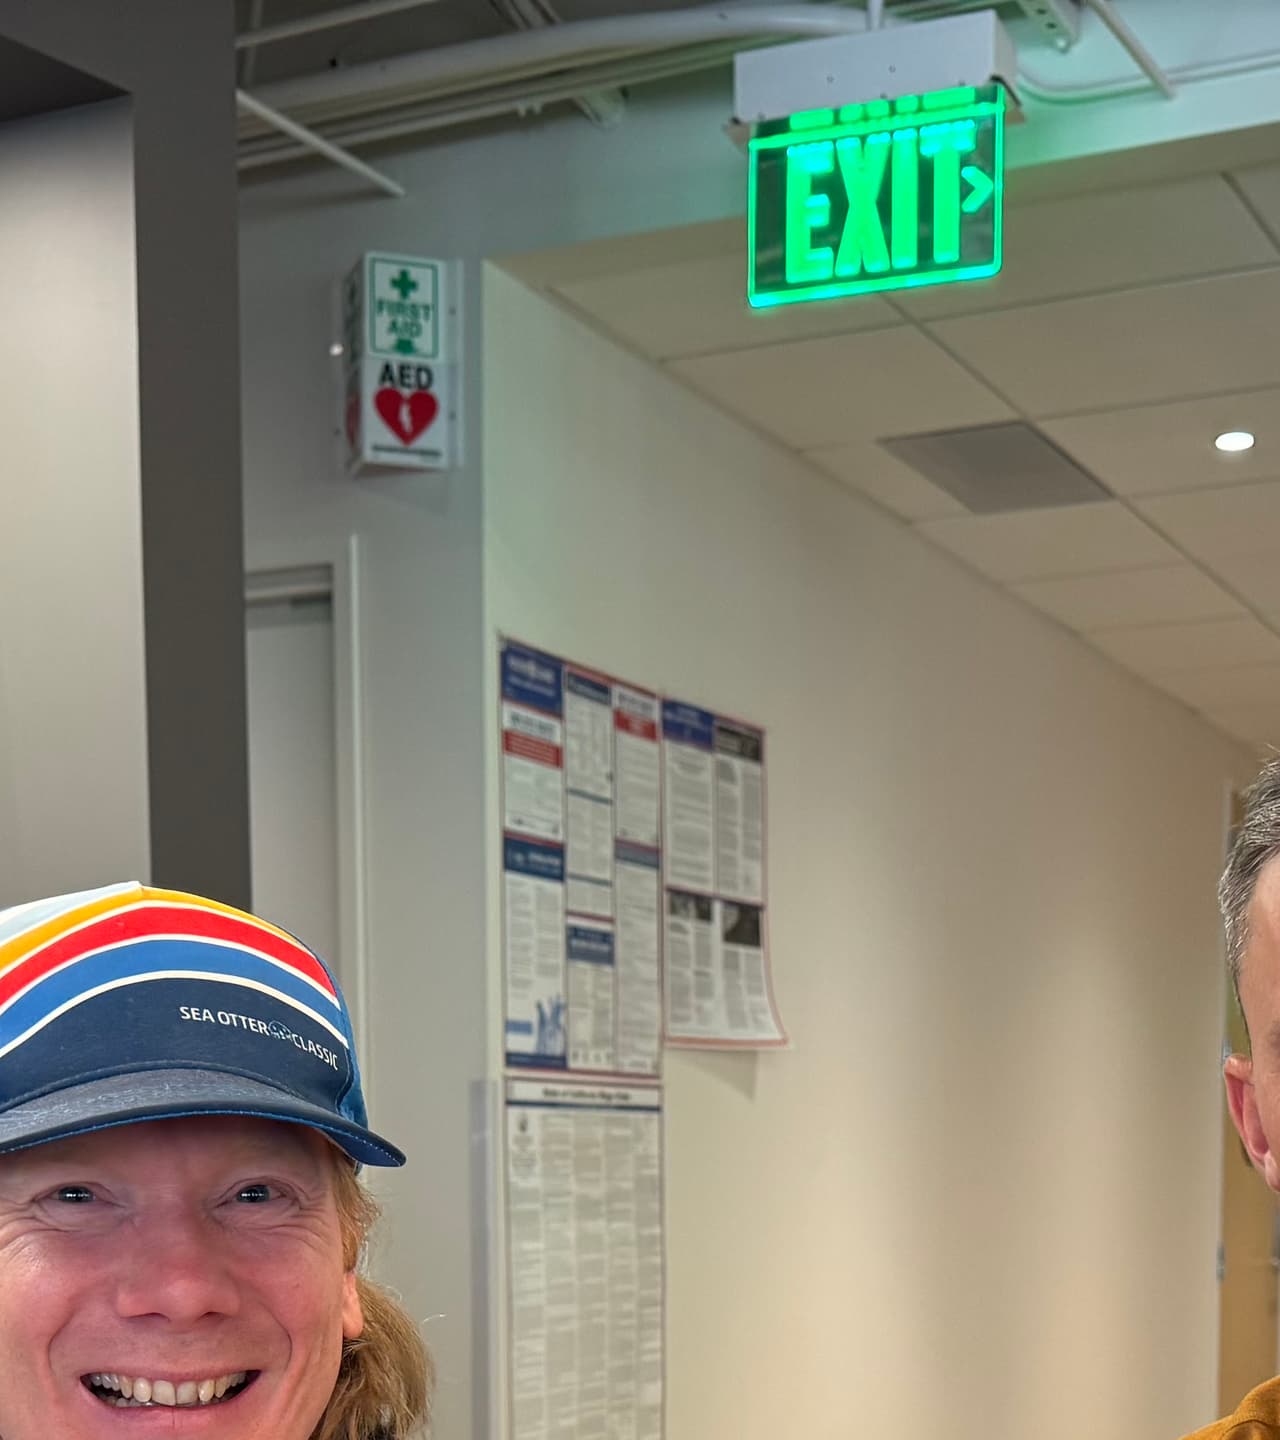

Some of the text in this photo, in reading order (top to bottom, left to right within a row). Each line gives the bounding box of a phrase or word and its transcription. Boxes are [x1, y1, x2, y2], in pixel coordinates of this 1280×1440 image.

[785, 118, 977, 285] EXIT
[376, 298, 433, 322] FIRST
[388, 319, 423, 339] AID
[378, 361, 434, 390] AED
[179, 1006, 339, 1071] SEA OTTER CLASSIC
